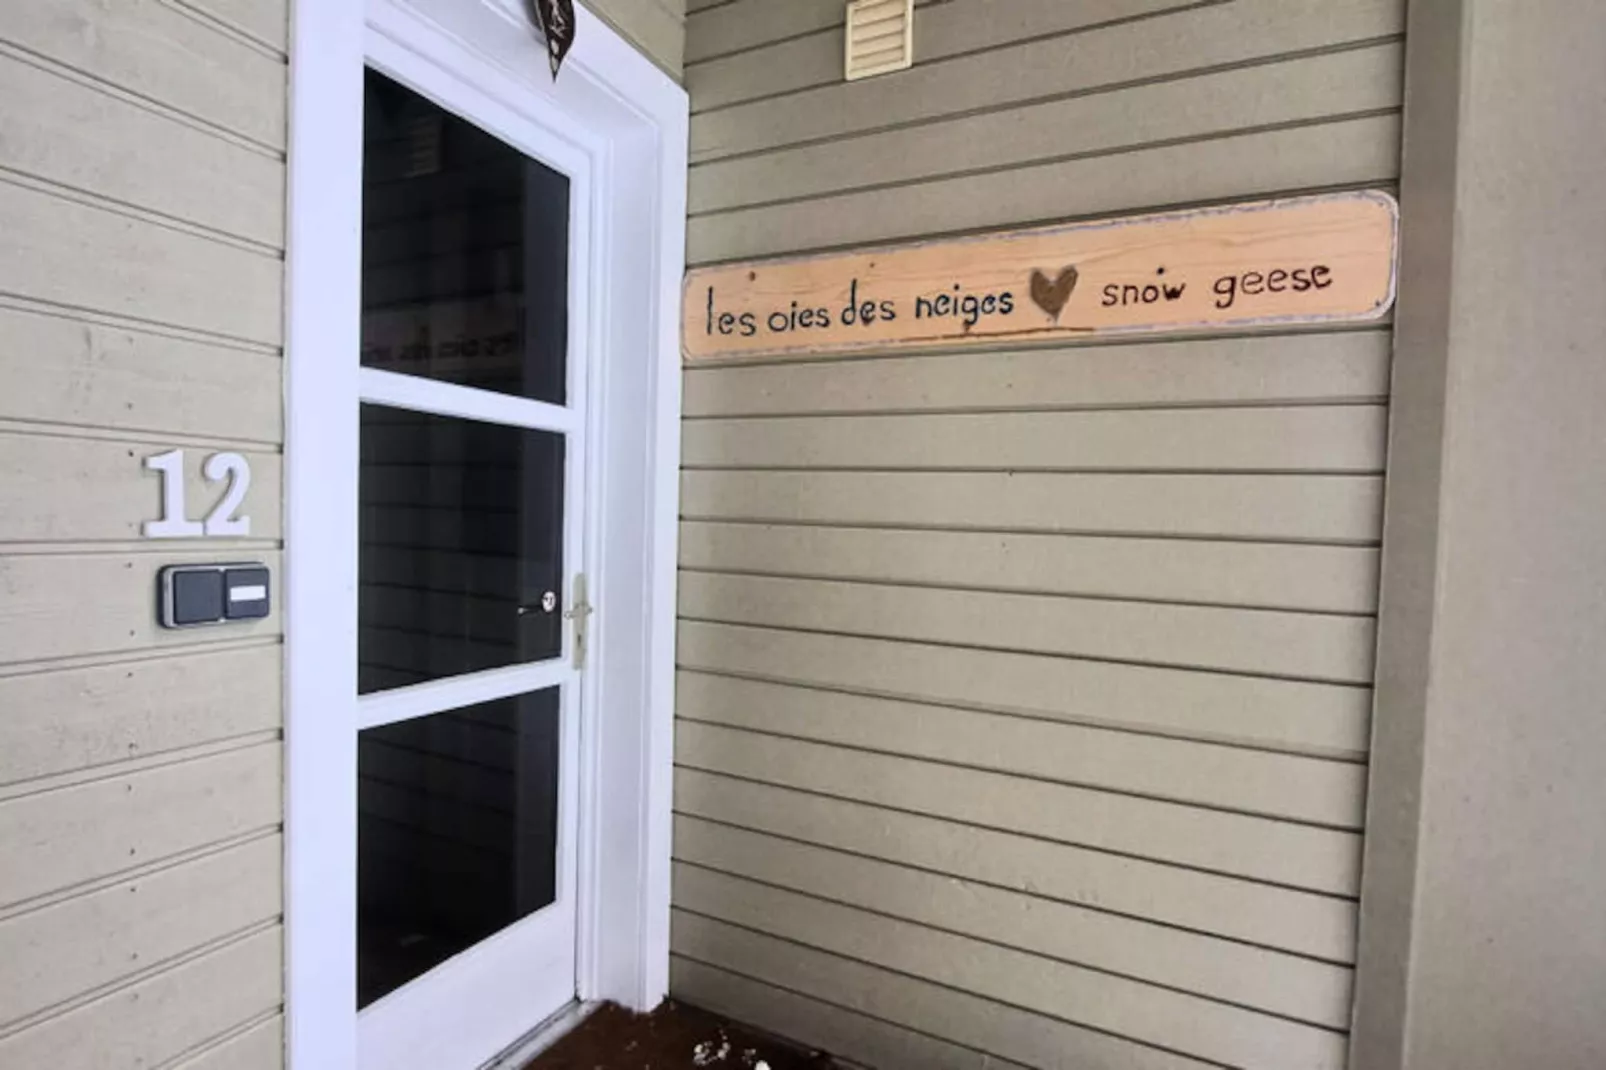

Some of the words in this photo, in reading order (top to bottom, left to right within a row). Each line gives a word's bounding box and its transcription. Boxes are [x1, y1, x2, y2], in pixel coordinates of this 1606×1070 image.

[706, 286, 757, 336] les
[768, 301, 831, 332] oies
[841, 278, 896, 325] des
[915, 283, 1015, 326] neiges
[1101, 281, 1187, 307] snow
[1213, 264, 1333, 309] geese
[142, 449, 251, 537] 12
